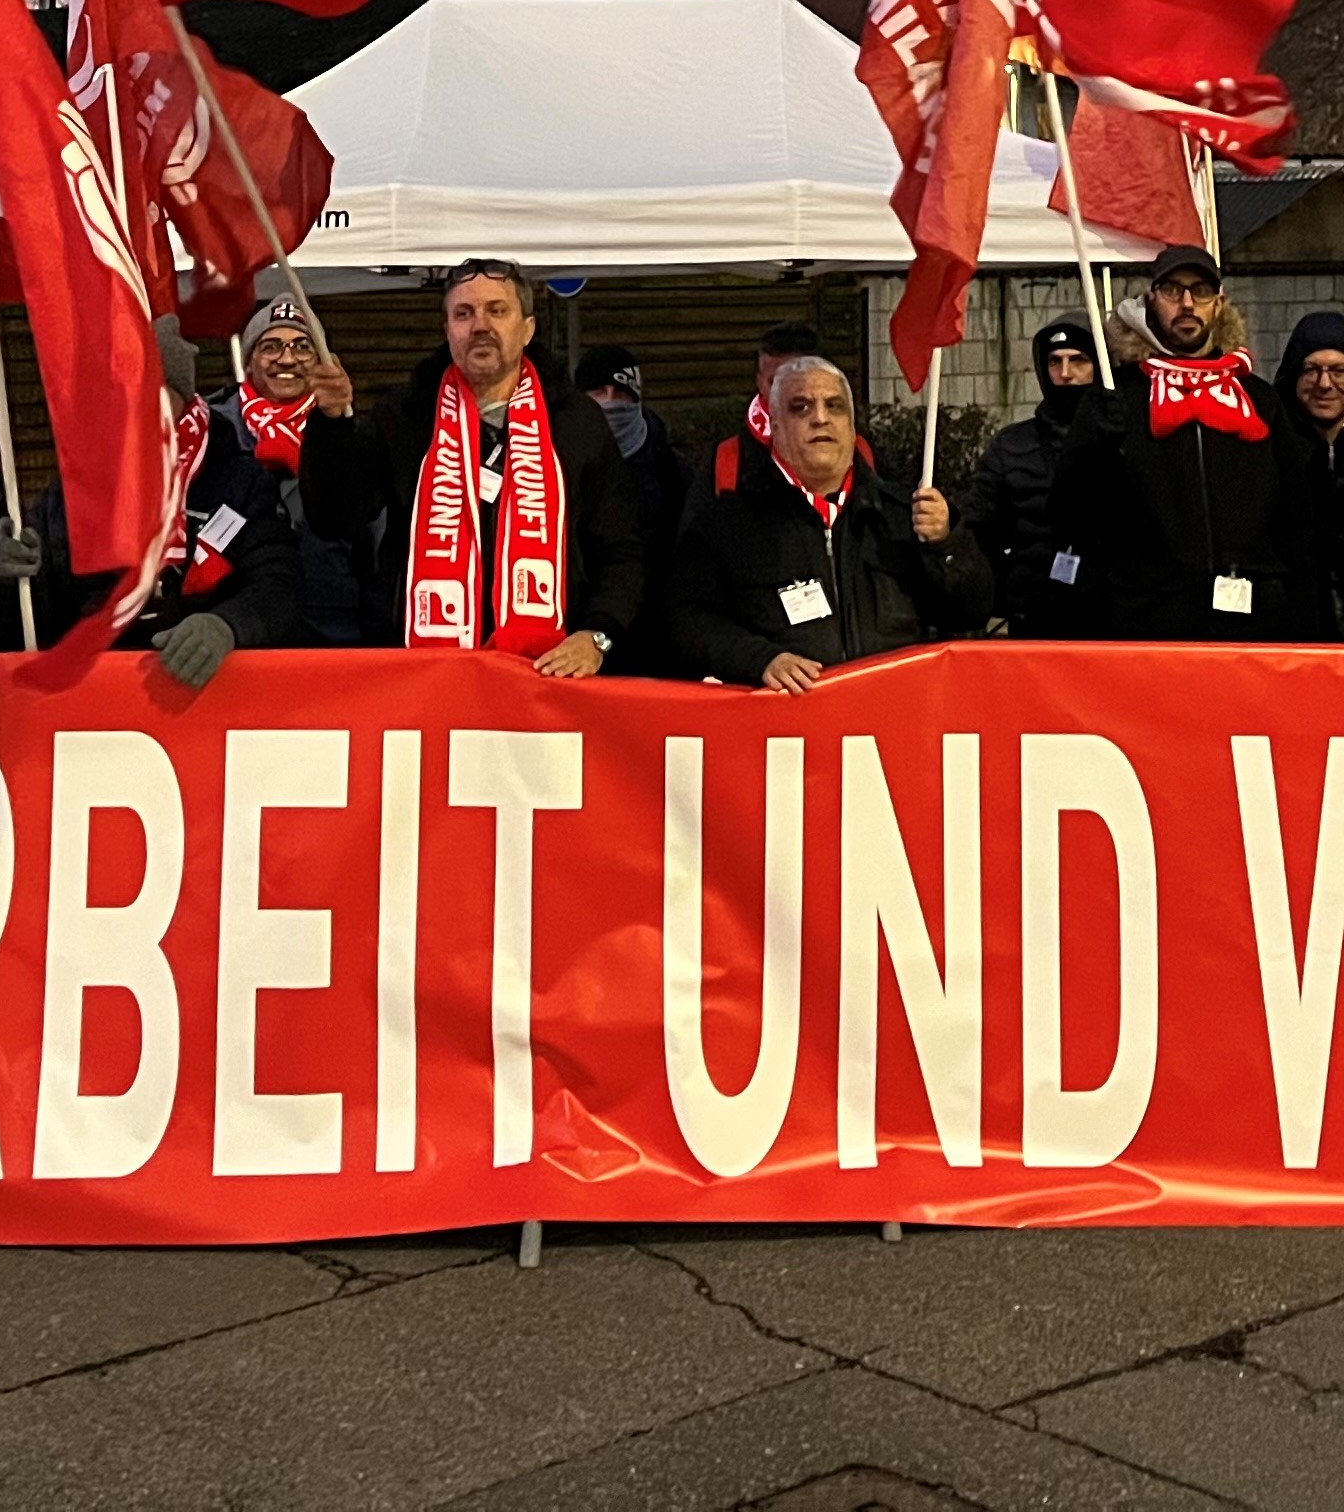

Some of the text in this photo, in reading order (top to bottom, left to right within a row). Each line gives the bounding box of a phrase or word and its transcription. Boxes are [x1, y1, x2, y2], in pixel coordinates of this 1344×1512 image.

[424, 428, 464, 564] ZUKUNFT
[508, 419, 549, 545] ZUKUNFT
[664, 733, 1159, 1178] UND
